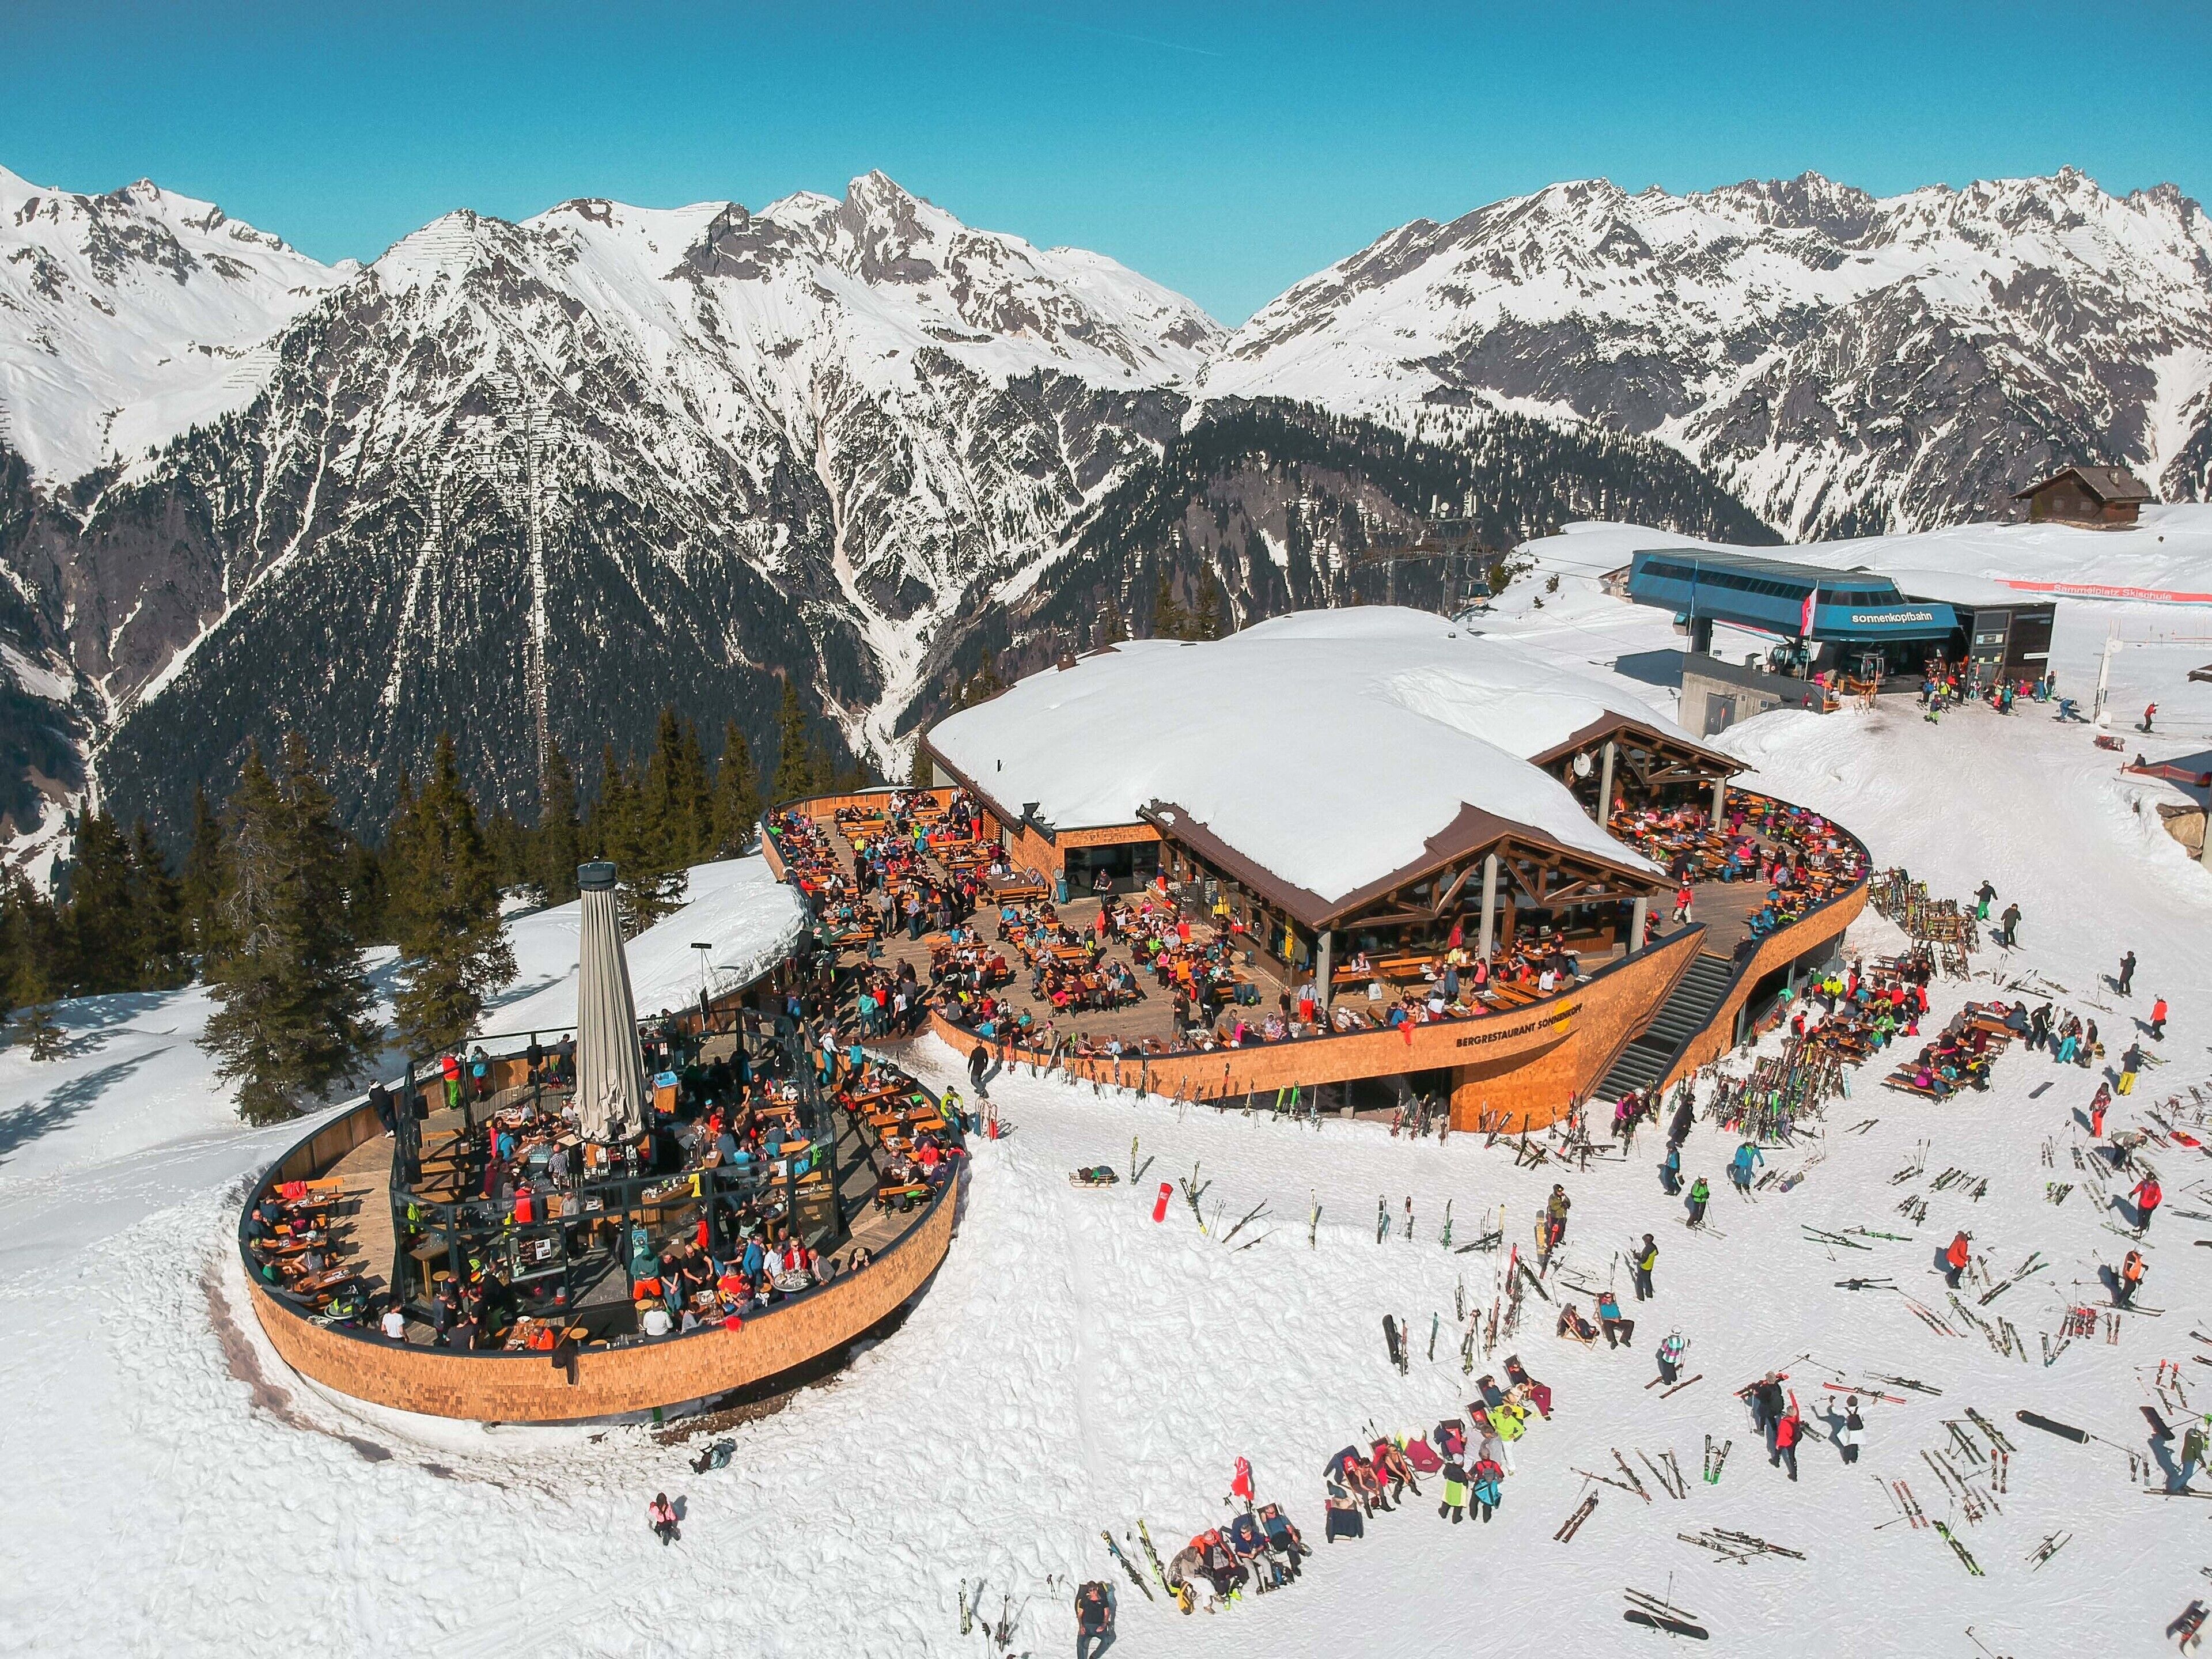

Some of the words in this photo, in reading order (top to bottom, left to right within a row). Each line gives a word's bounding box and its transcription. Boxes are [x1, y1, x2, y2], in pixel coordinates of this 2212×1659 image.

[2122, 589, 2172, 600] Skischule
[1852, 611, 1933, 624] sonnenkopfbahn
[1456, 1022, 1536, 1047] BERGRESTAURANT
[1537, 1003, 1583, 1029] SONNENKOPF
